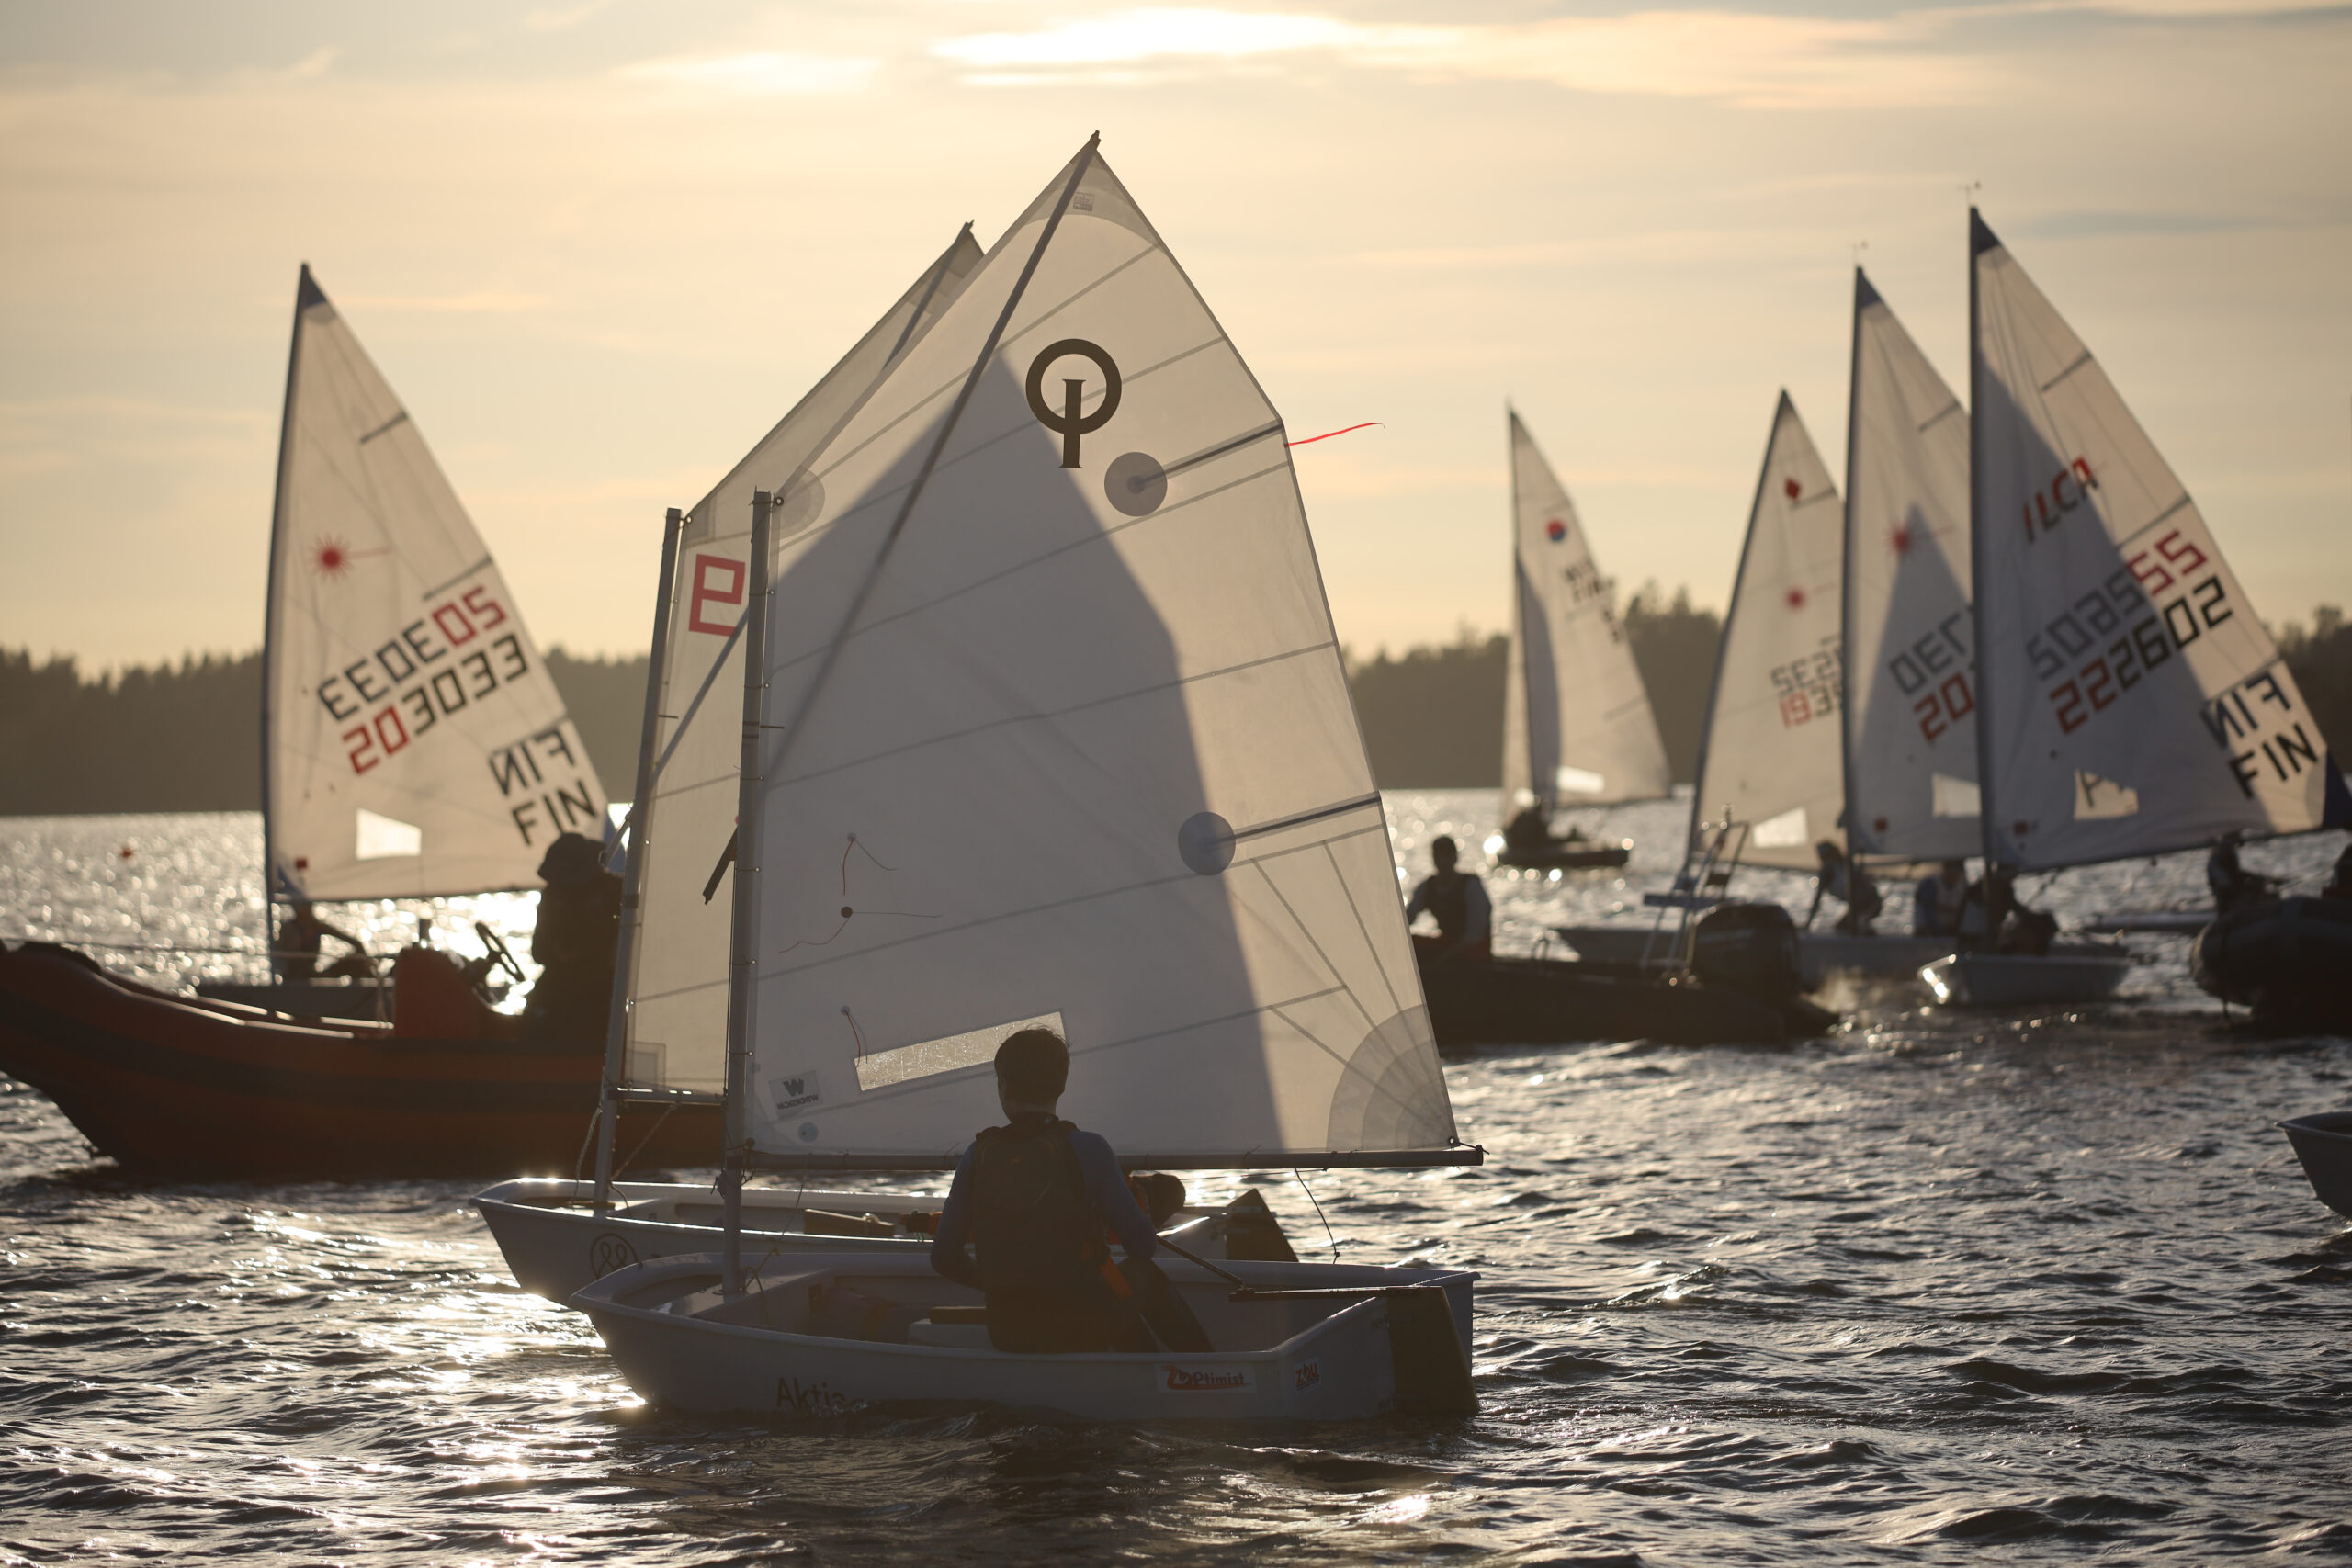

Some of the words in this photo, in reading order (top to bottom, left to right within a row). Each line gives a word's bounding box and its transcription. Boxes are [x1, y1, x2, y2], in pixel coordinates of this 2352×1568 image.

[2022, 456, 2098, 543] ILCA
[2049, 575, 2233, 734] 222602
[342, 634, 528, 774] 203033
[1913, 663, 1976, 742] 20
[2229, 724, 2319, 798] FIN
[511, 780, 598, 846] FIN
